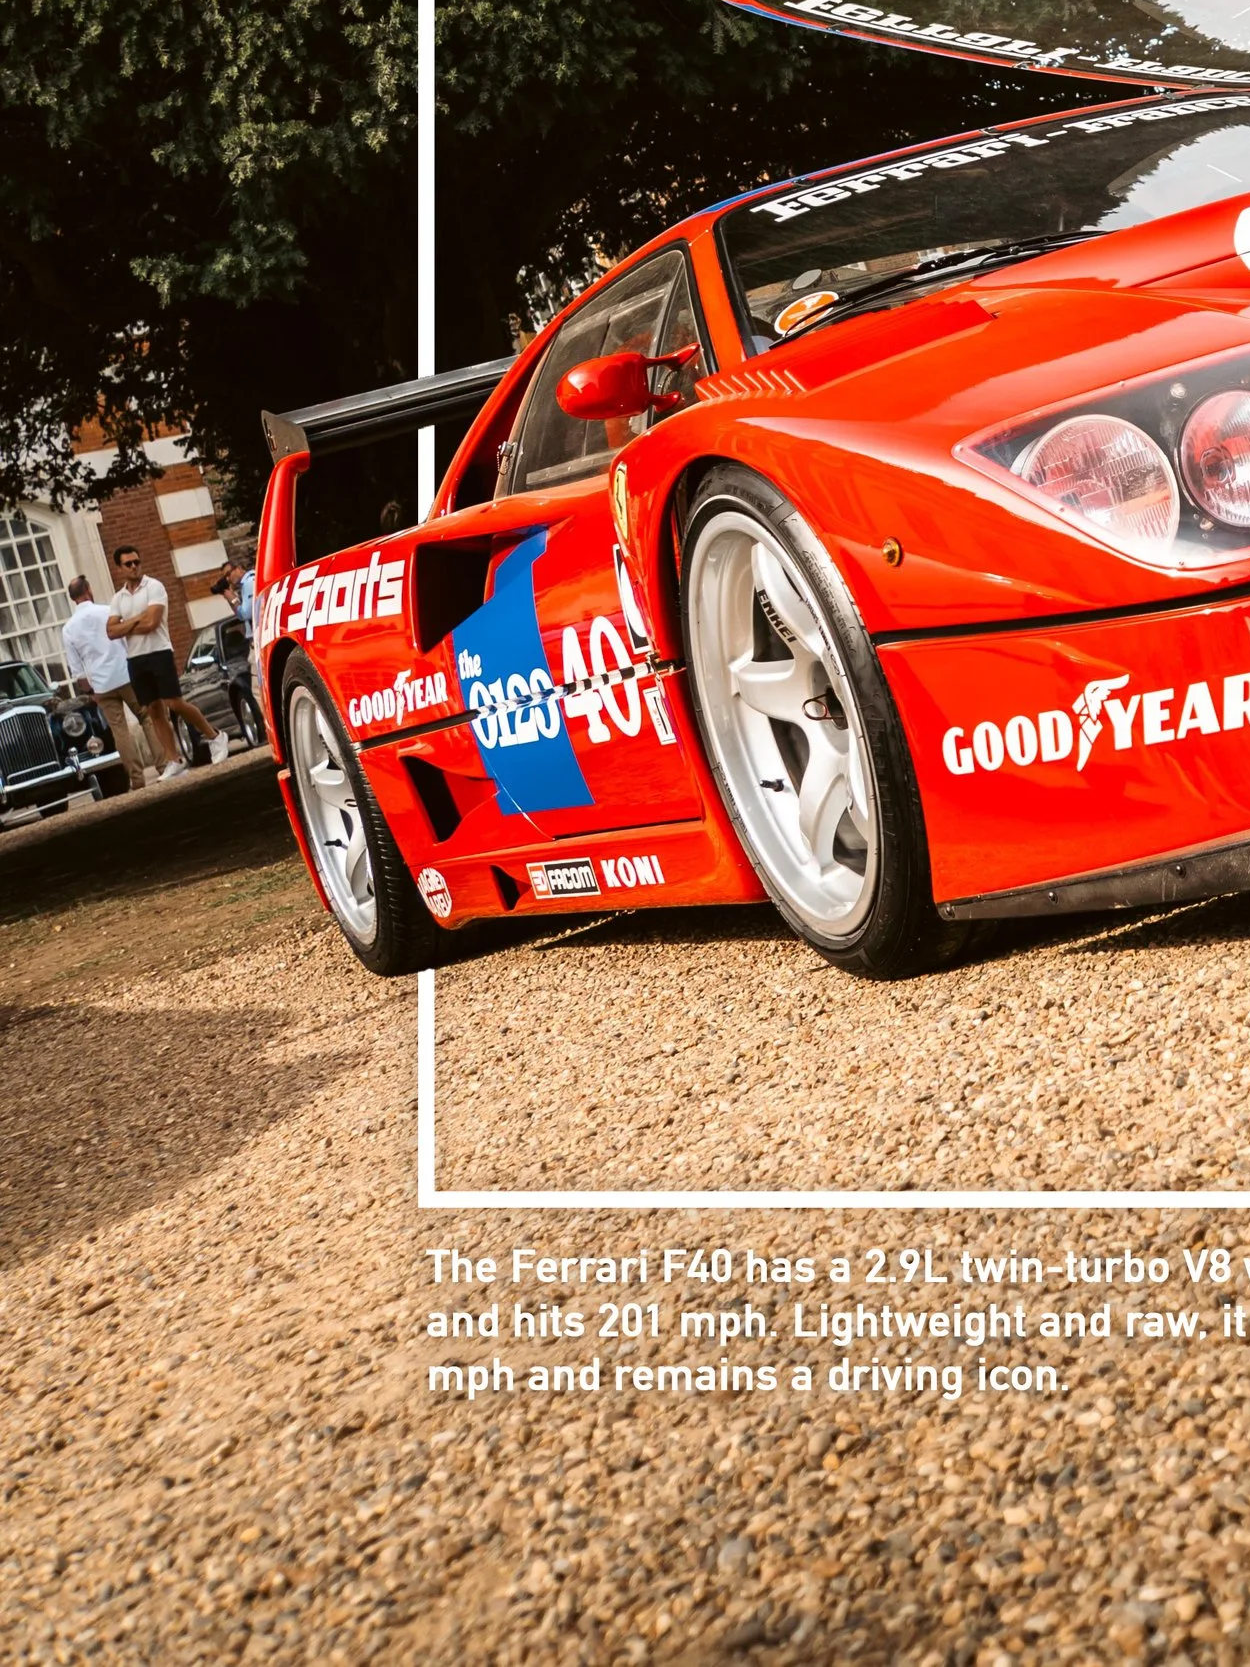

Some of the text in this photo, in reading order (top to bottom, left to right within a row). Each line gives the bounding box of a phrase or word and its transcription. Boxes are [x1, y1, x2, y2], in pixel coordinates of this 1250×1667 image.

[287, 550, 406, 642] Sports
[757, 588, 797, 643] ENKEI
[458, 648, 483, 680] the
[469, 615, 643, 749] 0123 40
[348, 669, 449, 728] GOODYEAR
[547, 865, 596, 891] FACOM
[600, 854, 666, 889] KONI
